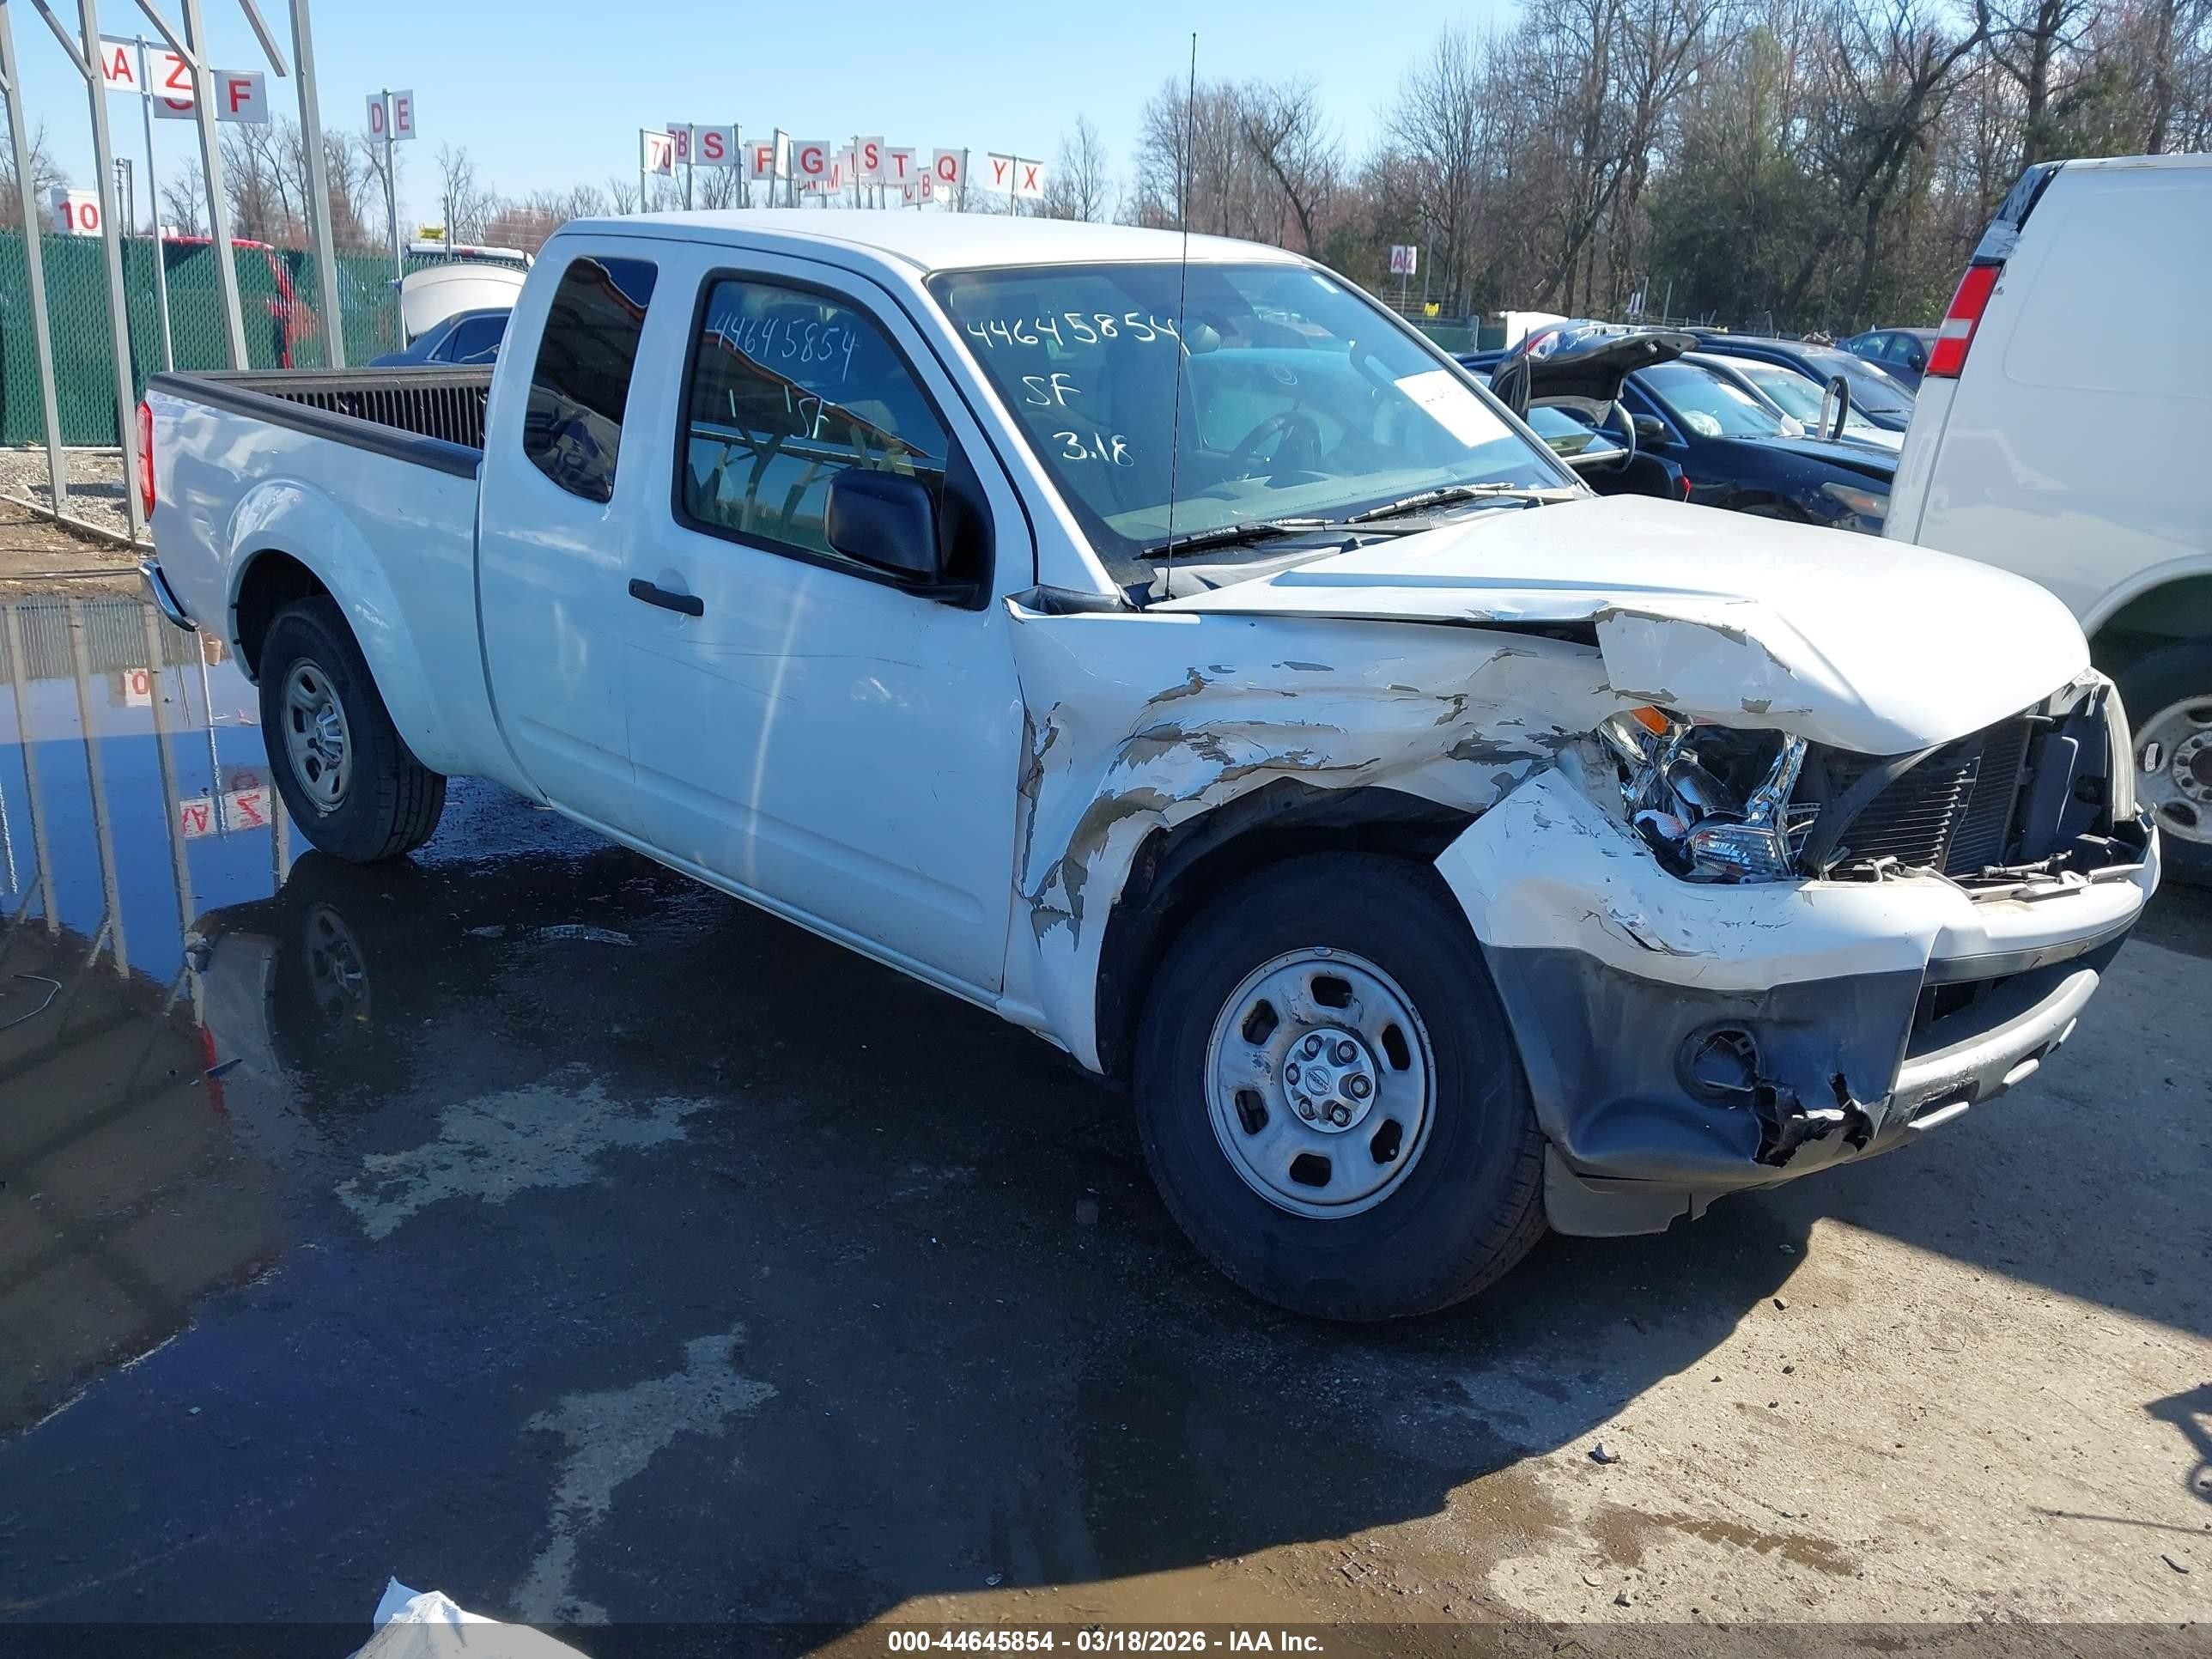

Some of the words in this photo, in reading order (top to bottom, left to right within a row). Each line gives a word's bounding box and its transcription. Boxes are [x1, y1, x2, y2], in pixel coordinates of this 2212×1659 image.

[165, 54, 193, 91] Z
[228, 79, 252, 113] F
[370, 102, 384, 134] D
[397, 99, 410, 131] E
[703, 131, 725, 159] S
[800, 146, 824, 174] G
[864, 143, 878, 170] S
[891, 154, 909, 179] T
[937, 155, 957, 183] Q
[992, 159, 1008, 185] Y
[1024, 165, 1038, 191] X
[921, 173, 932, 198] B
[58, 201, 99, 231] 10
[713, 312, 860, 383] 44645854
[966, 311, 1192, 356] 44645854
[1021, 373, 1082, 407] SF
[789, 396, 836, 441] SF
[1052, 431, 1134, 467] 3.18
